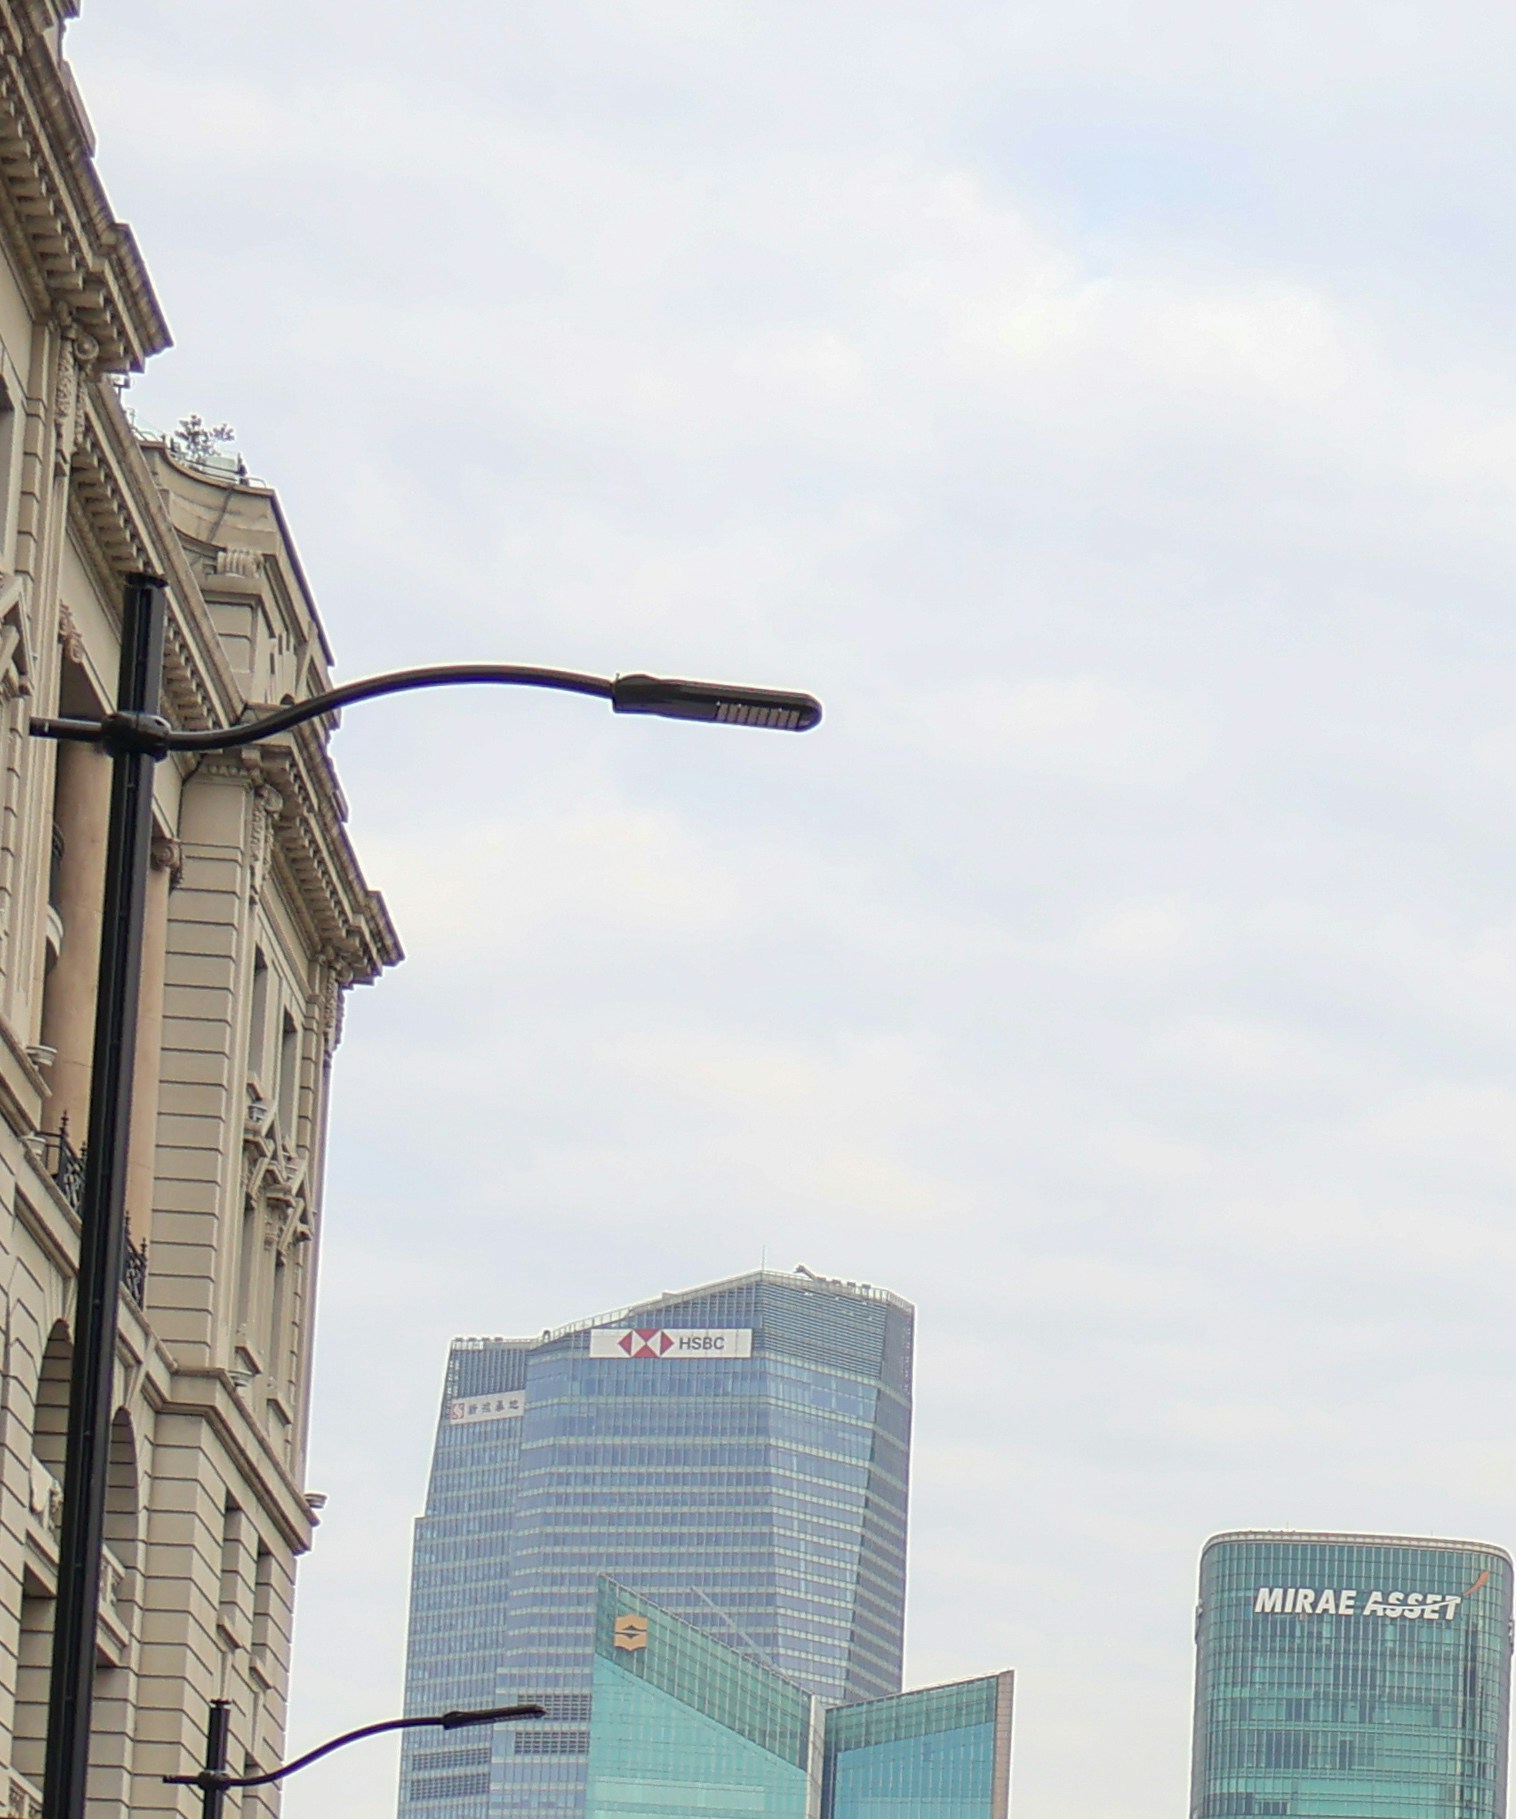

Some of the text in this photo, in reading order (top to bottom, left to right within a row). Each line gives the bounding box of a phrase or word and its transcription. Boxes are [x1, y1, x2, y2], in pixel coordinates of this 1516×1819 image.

[679, 1336, 725, 1351] HSBC
[1254, 1587, 1462, 1620] MIRAE ASSET
